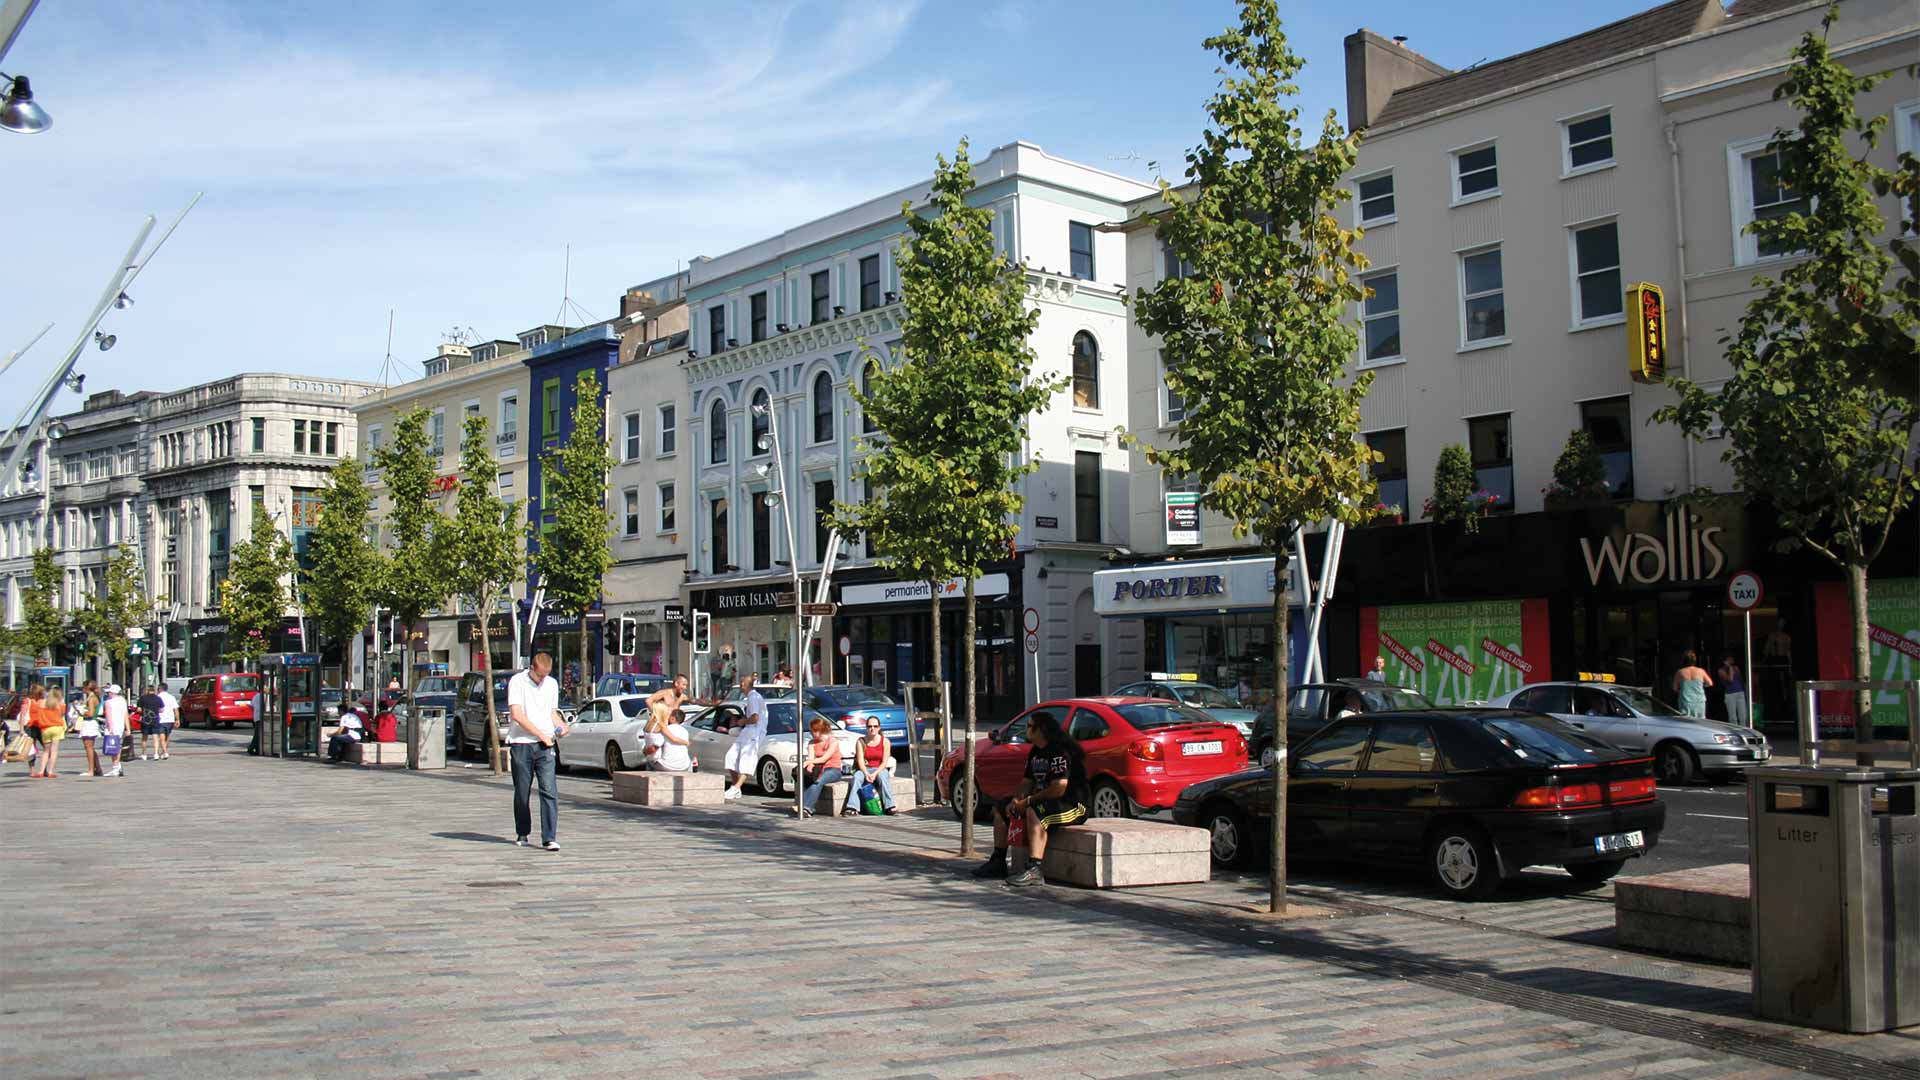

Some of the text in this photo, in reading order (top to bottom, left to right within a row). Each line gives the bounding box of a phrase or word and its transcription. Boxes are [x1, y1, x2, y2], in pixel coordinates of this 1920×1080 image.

[884, 584, 929, 600] permanent
[1112, 574, 1225, 602] PORTER
[1733, 589, 1756, 600] TAXI
[718, 592, 747, 609] RIVER
[1776, 827, 1818, 843] Litter
